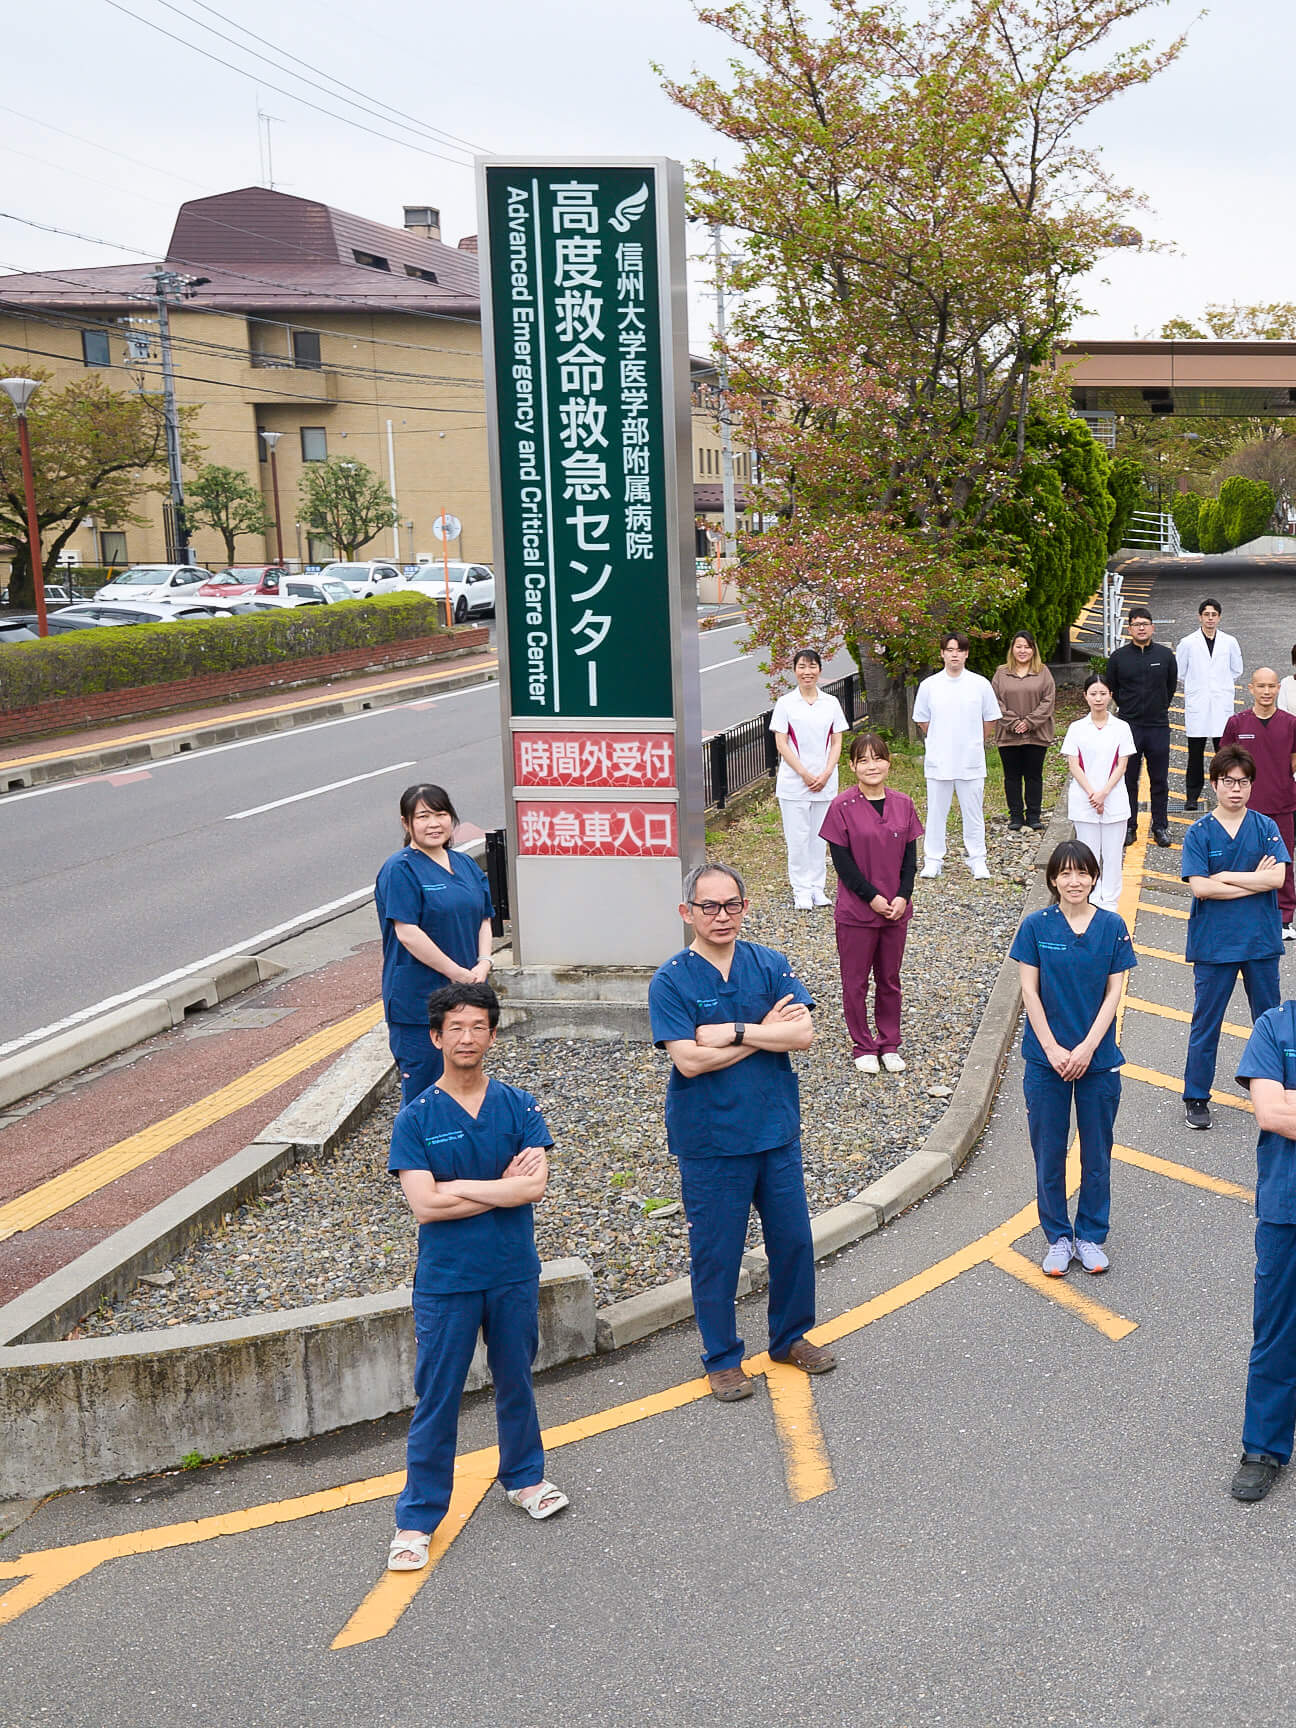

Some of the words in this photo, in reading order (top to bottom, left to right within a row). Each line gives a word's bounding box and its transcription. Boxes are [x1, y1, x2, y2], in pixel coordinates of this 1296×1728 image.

[507, 186, 533, 301] Advanced
[512, 307, 534, 434] Emergency
[614, 243, 654, 560] 信州大学医学部附属病院
[518, 440, 541, 481] and
[549, 180, 613, 707] 高度救命救急センター
[520, 487, 545, 567] Critical
[524, 573, 546, 625] Care
[526, 631, 548, 706] Center
[520, 741, 672, 778] 時間外受付
[522, 811, 671, 847] 救急車入口
